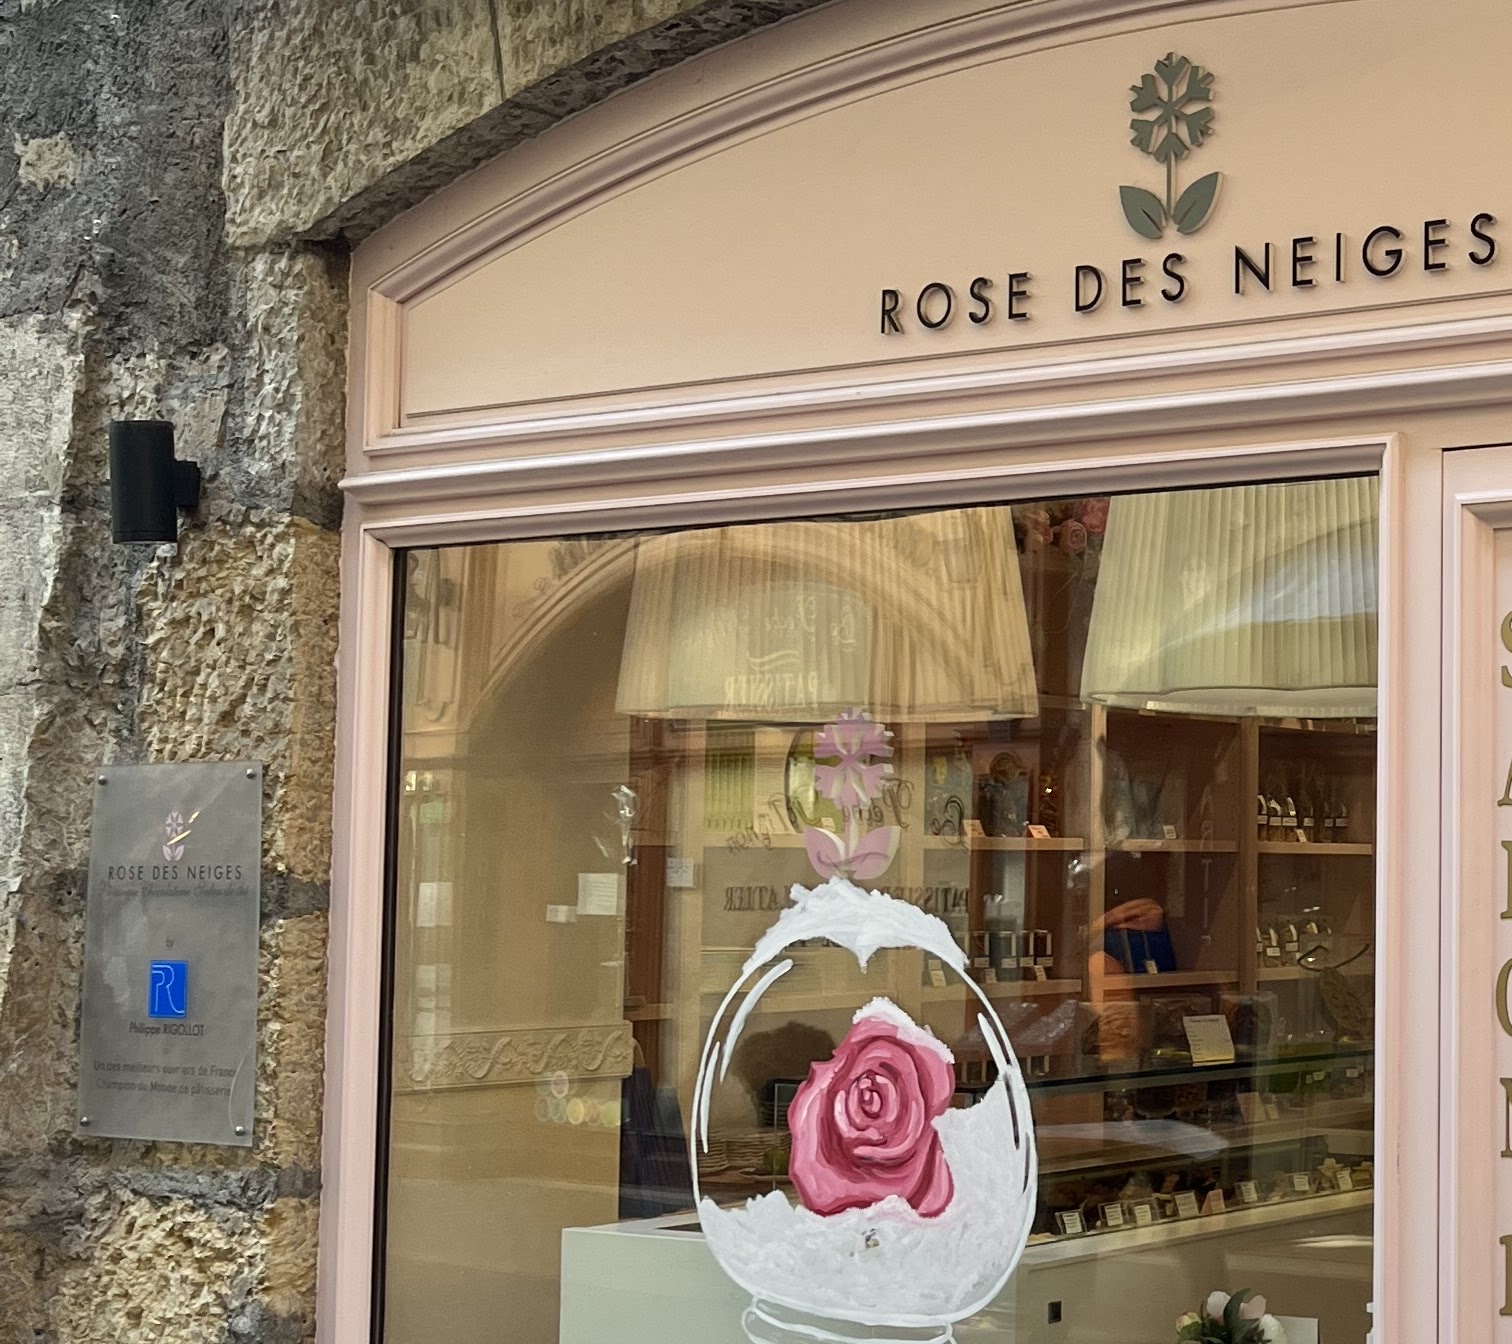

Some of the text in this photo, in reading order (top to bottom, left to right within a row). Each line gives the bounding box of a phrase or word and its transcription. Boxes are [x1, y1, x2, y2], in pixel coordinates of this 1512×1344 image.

[880, 212, 1498, 335] ROSE DES NEIGES
[108, 864, 242, 881] ROSE DES NEIGES
[163, 1023, 205, 1036] RIGOLLOT
